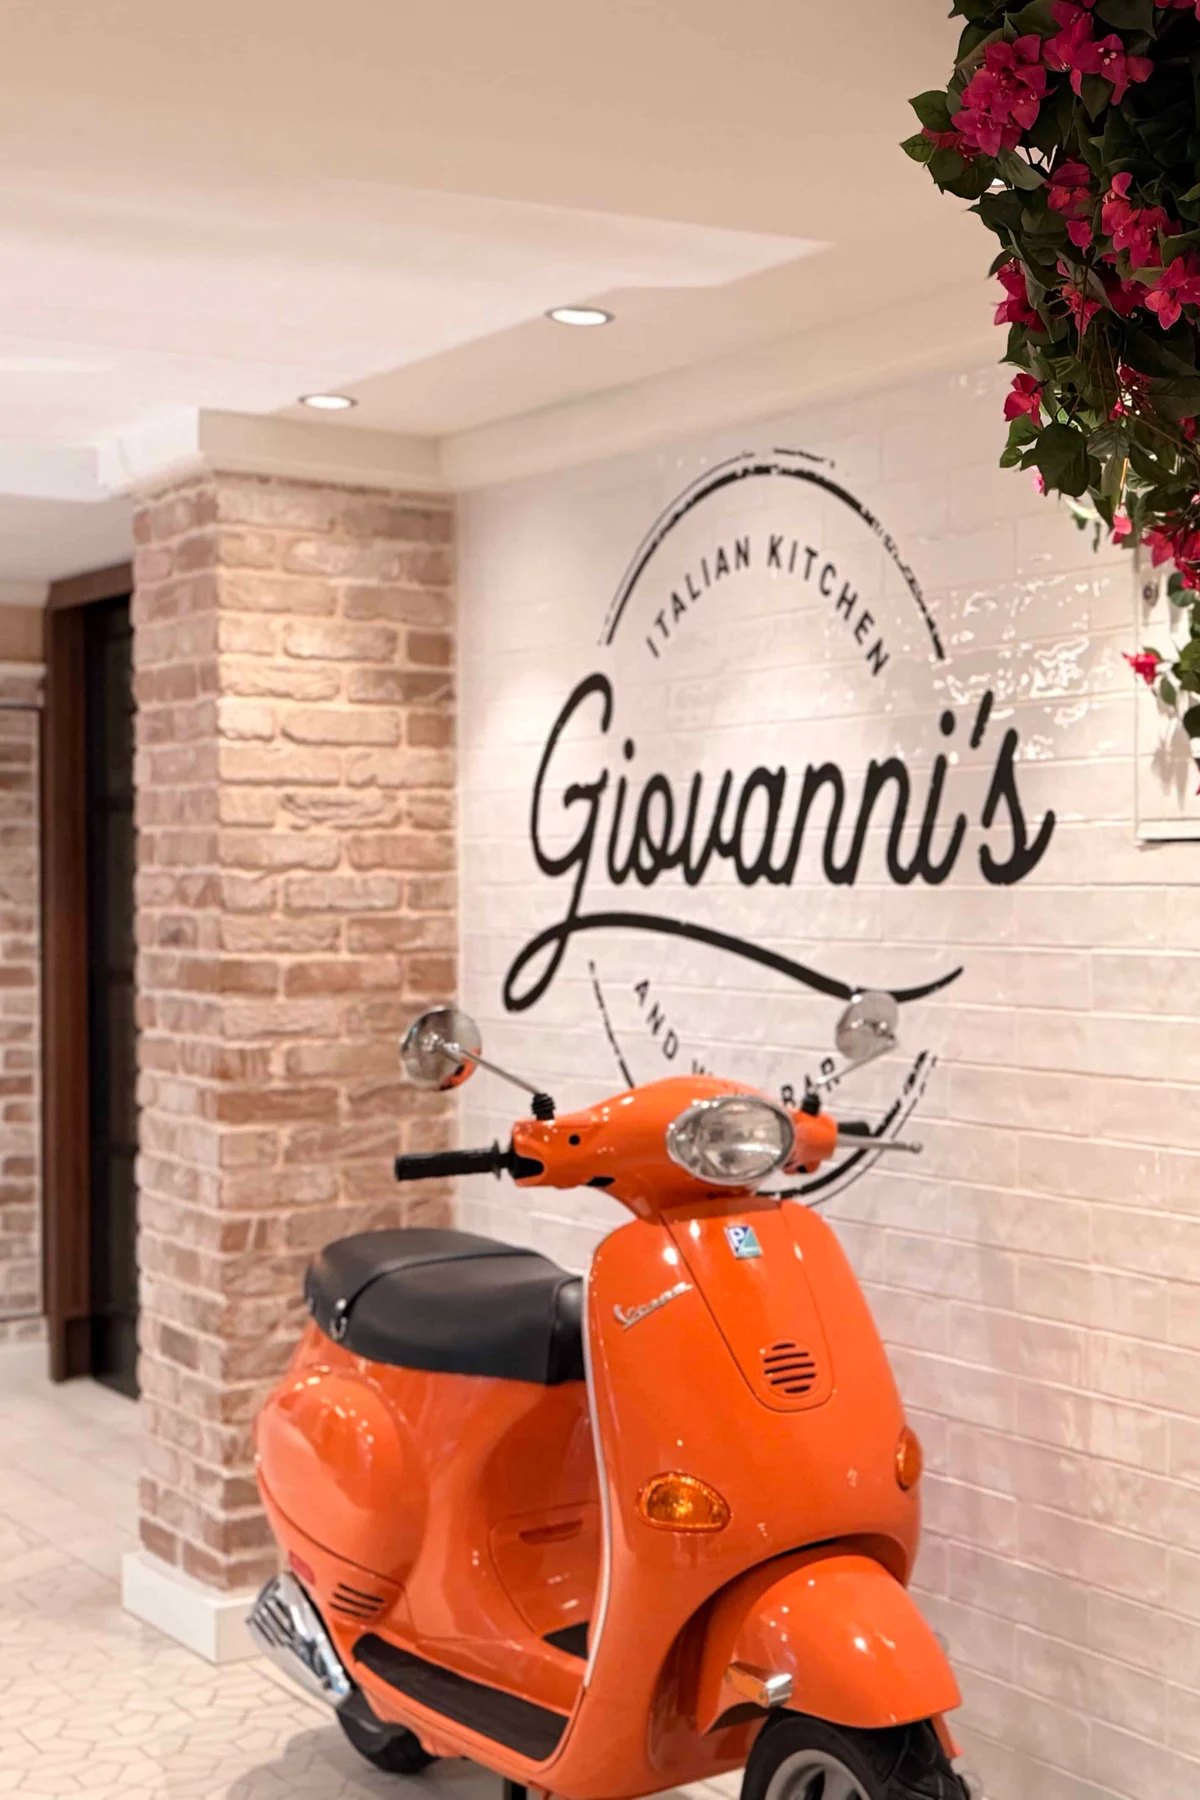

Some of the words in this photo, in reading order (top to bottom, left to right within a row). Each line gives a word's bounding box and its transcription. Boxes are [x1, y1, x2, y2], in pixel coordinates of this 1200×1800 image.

[645, 535, 752, 657] ITALIAN
[766, 535, 890, 677] KITCHEN
[502, 672, 1056, 1010] Giovanni's
[634, 979, 680, 1060] AND
